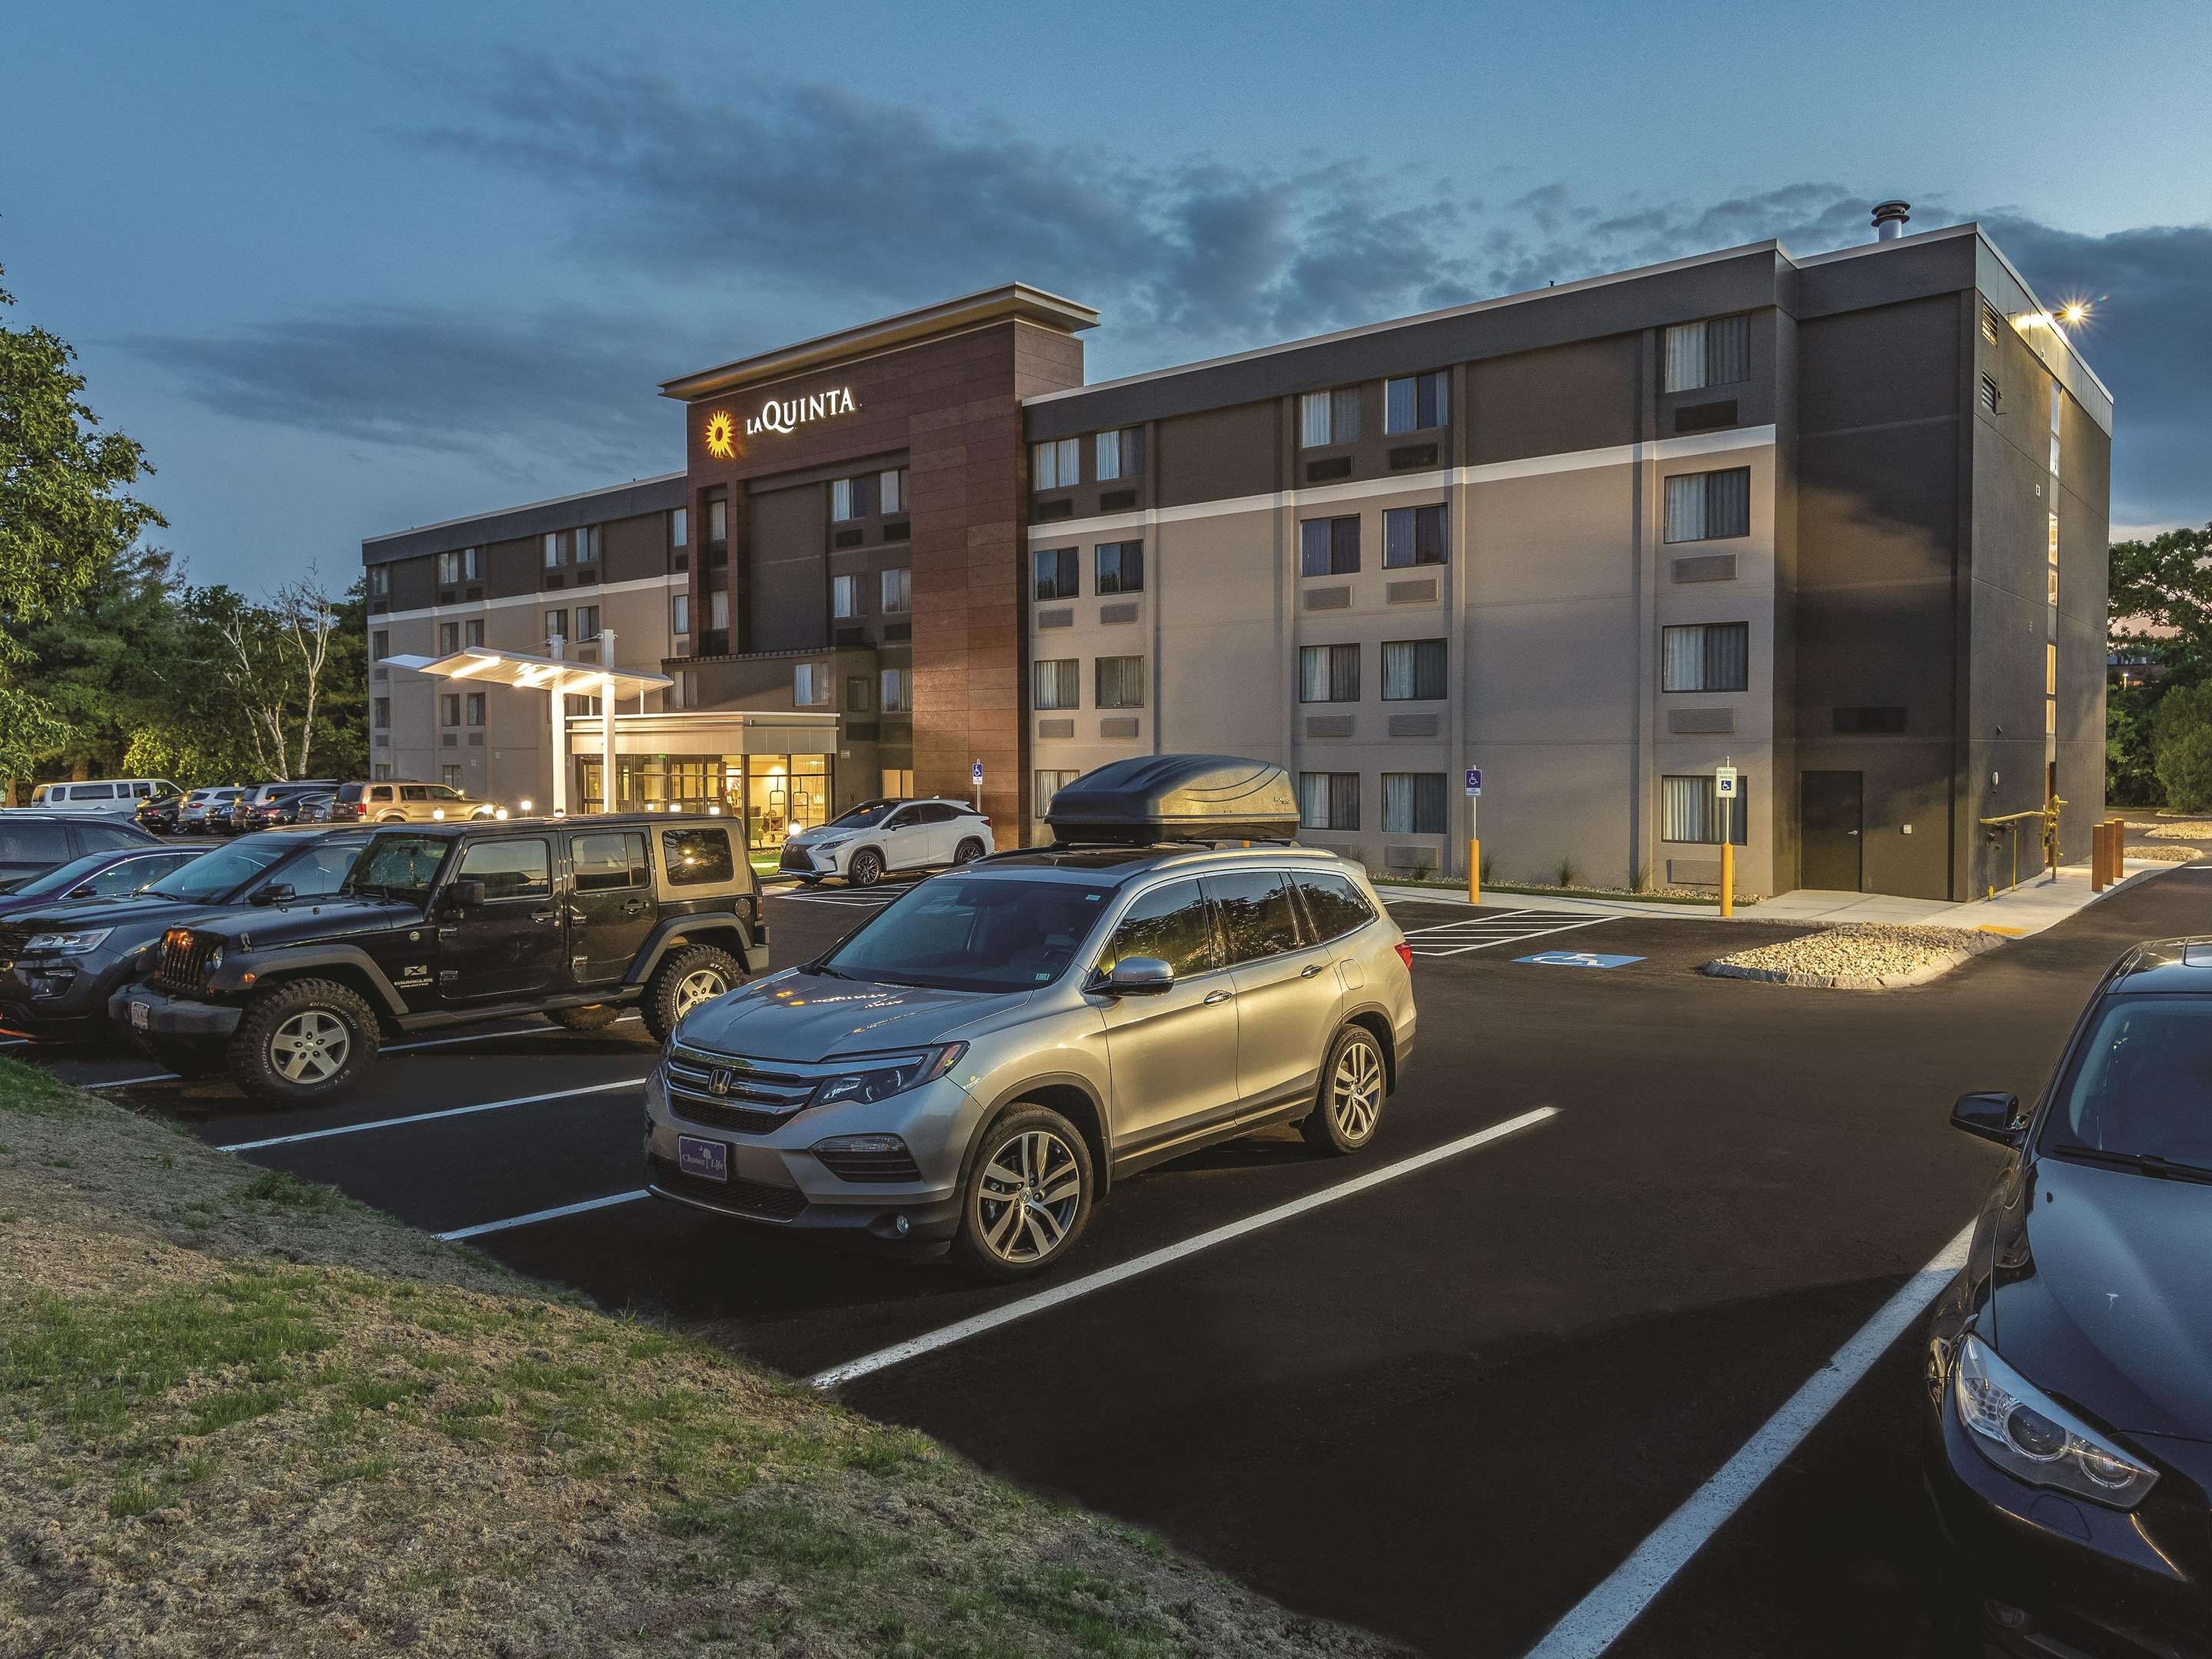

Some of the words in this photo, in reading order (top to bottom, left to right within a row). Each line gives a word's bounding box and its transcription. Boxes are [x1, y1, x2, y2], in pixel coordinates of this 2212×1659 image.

[747, 416, 762, 435] LA
[762, 386, 855, 433] QUINTA
[261, 1032, 272, 1075] COOPER
[682, 1154, 705, 1166] Choose
[710, 1158, 724, 1171] Life
